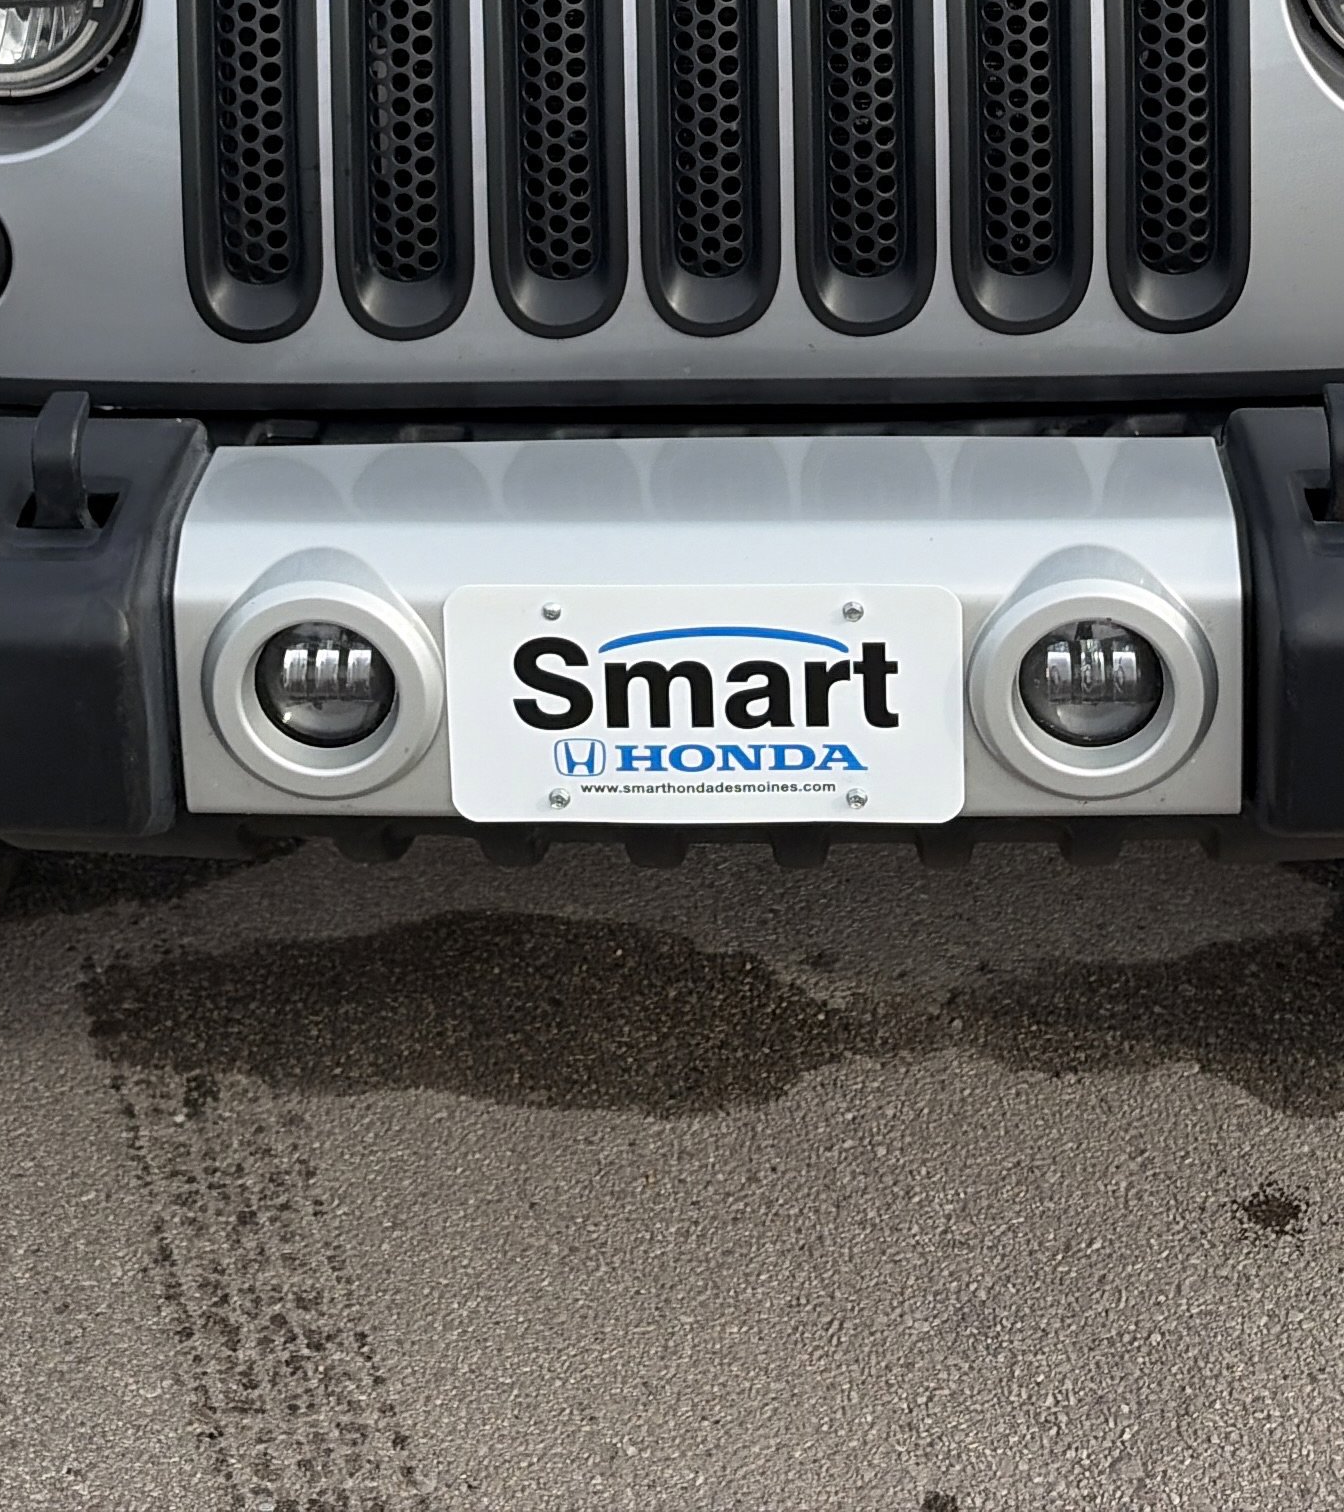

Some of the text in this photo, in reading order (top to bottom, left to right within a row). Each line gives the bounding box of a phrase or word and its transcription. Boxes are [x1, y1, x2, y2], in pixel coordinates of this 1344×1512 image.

[513, 636, 899, 731] Smart
[615, 744, 868, 772] HONDA
[580, 781, 836, 795] www.smarthondadesmoines.com
